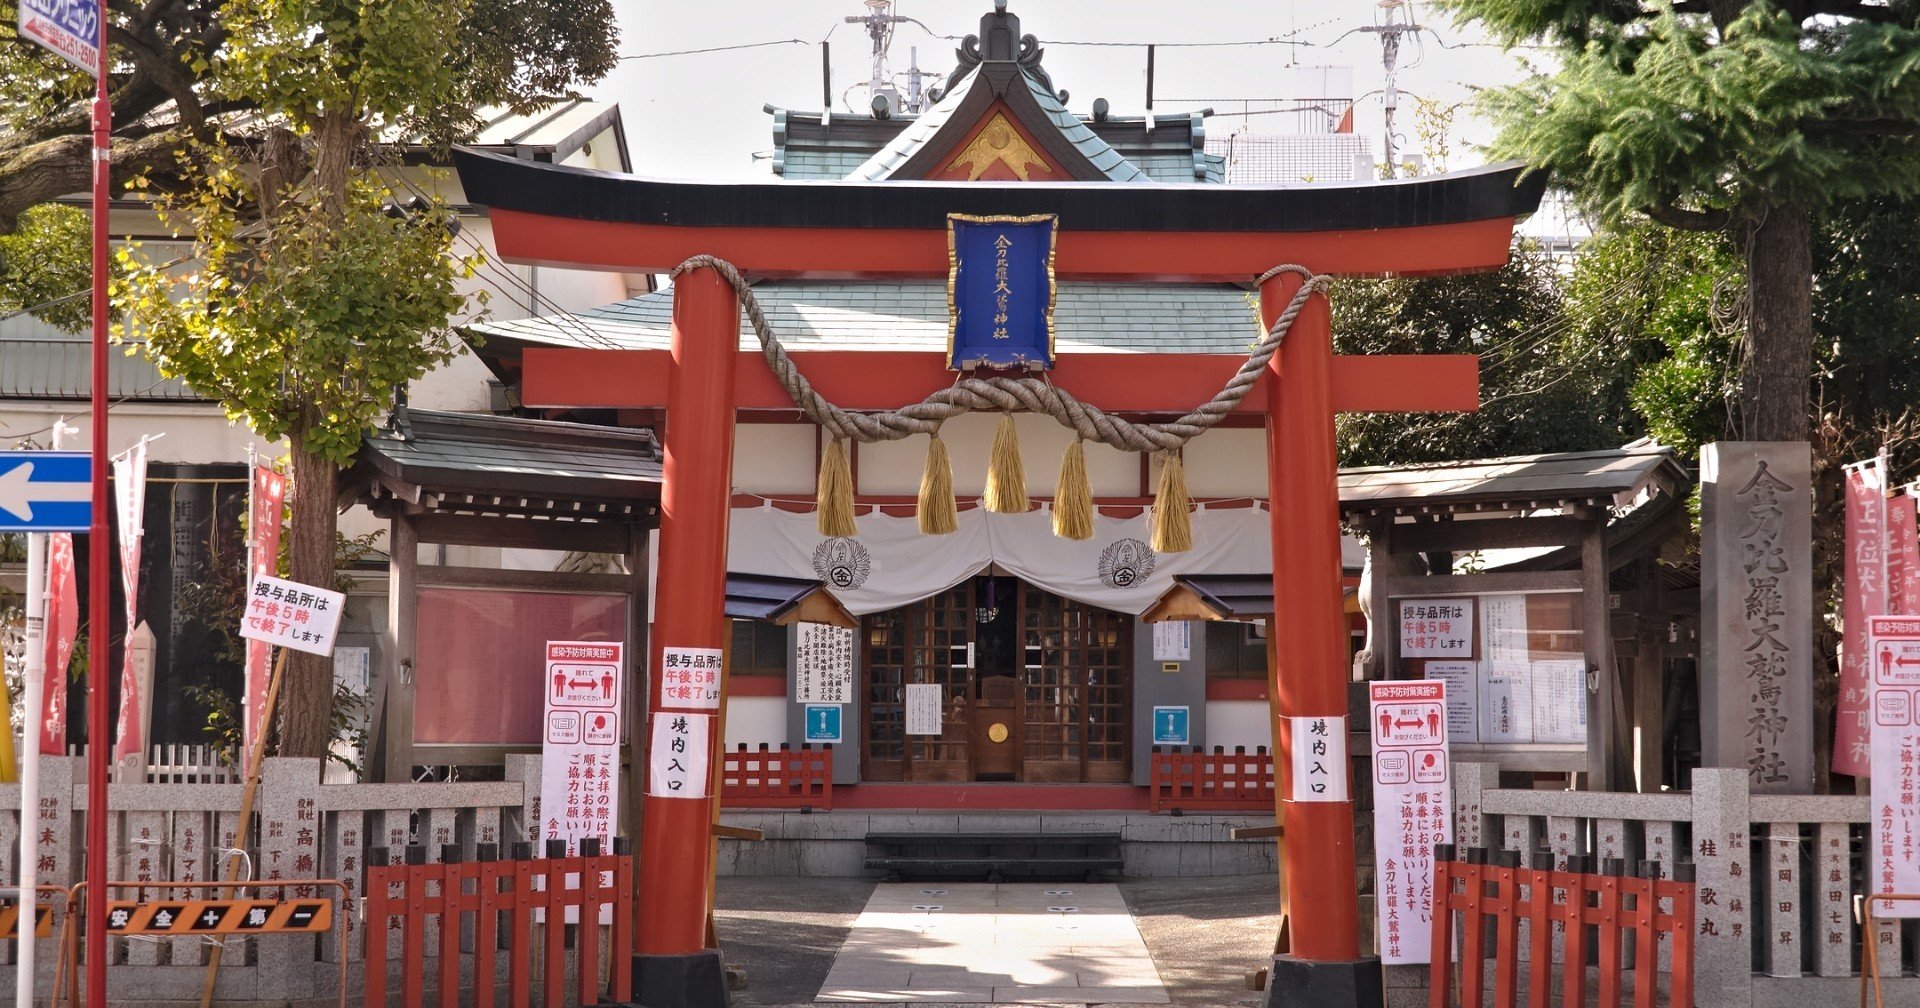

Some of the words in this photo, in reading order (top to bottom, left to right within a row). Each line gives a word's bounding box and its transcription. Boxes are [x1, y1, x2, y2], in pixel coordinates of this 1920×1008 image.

[248, 616, 325, 645] で終了します
[255, 581, 330, 611] 授与品所は
[1403, 605, 1463, 619] 授与品所は
[1737, 460, 1795, 785] 金刀比羅大鷲神社
[1404, 637, 1466, 649] で終了します
[667, 716, 689, 791] 境内入口
[1310, 718, 1329, 794] 境内入口
[1900, 735, 1914, 863] ご協力お願いします
[1401, 792, 1416, 912] ご協力お願いします
[1700, 839, 1719, 936] 桂歌丸
[1385, 858, 1401, 958] 金刀比羅大鷲神社
[1828, 868, 1843, 945] 藤田七郎
